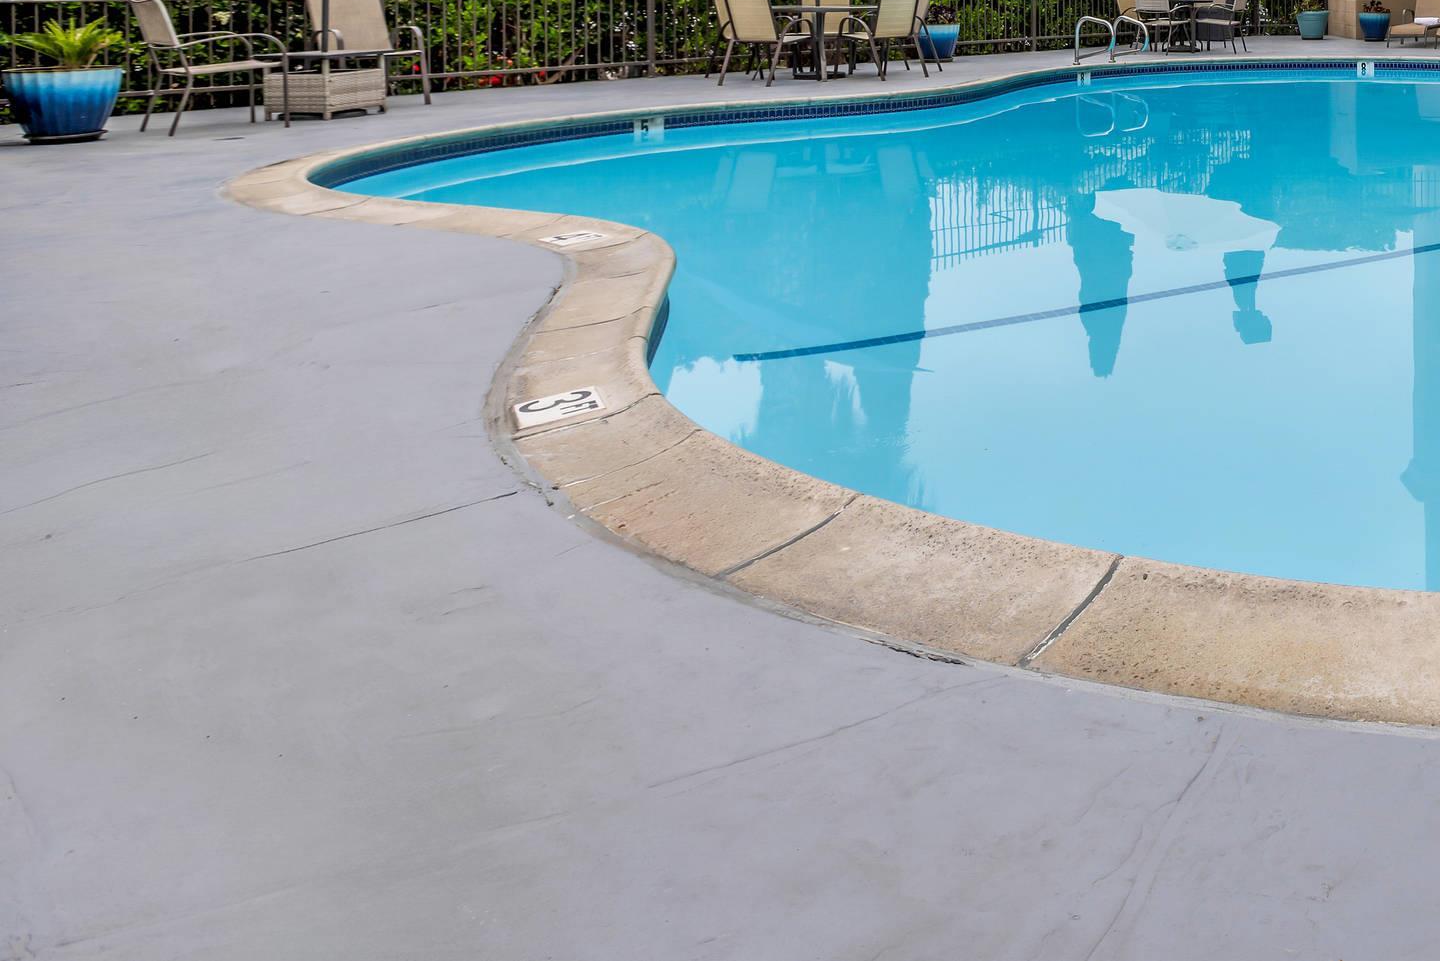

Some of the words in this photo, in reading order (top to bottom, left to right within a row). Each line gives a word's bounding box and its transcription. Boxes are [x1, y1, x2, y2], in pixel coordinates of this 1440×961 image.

[641, 119, 649, 131] 5
[518, 390, 593, 414] 3
[560, 400, 599, 415] FT
